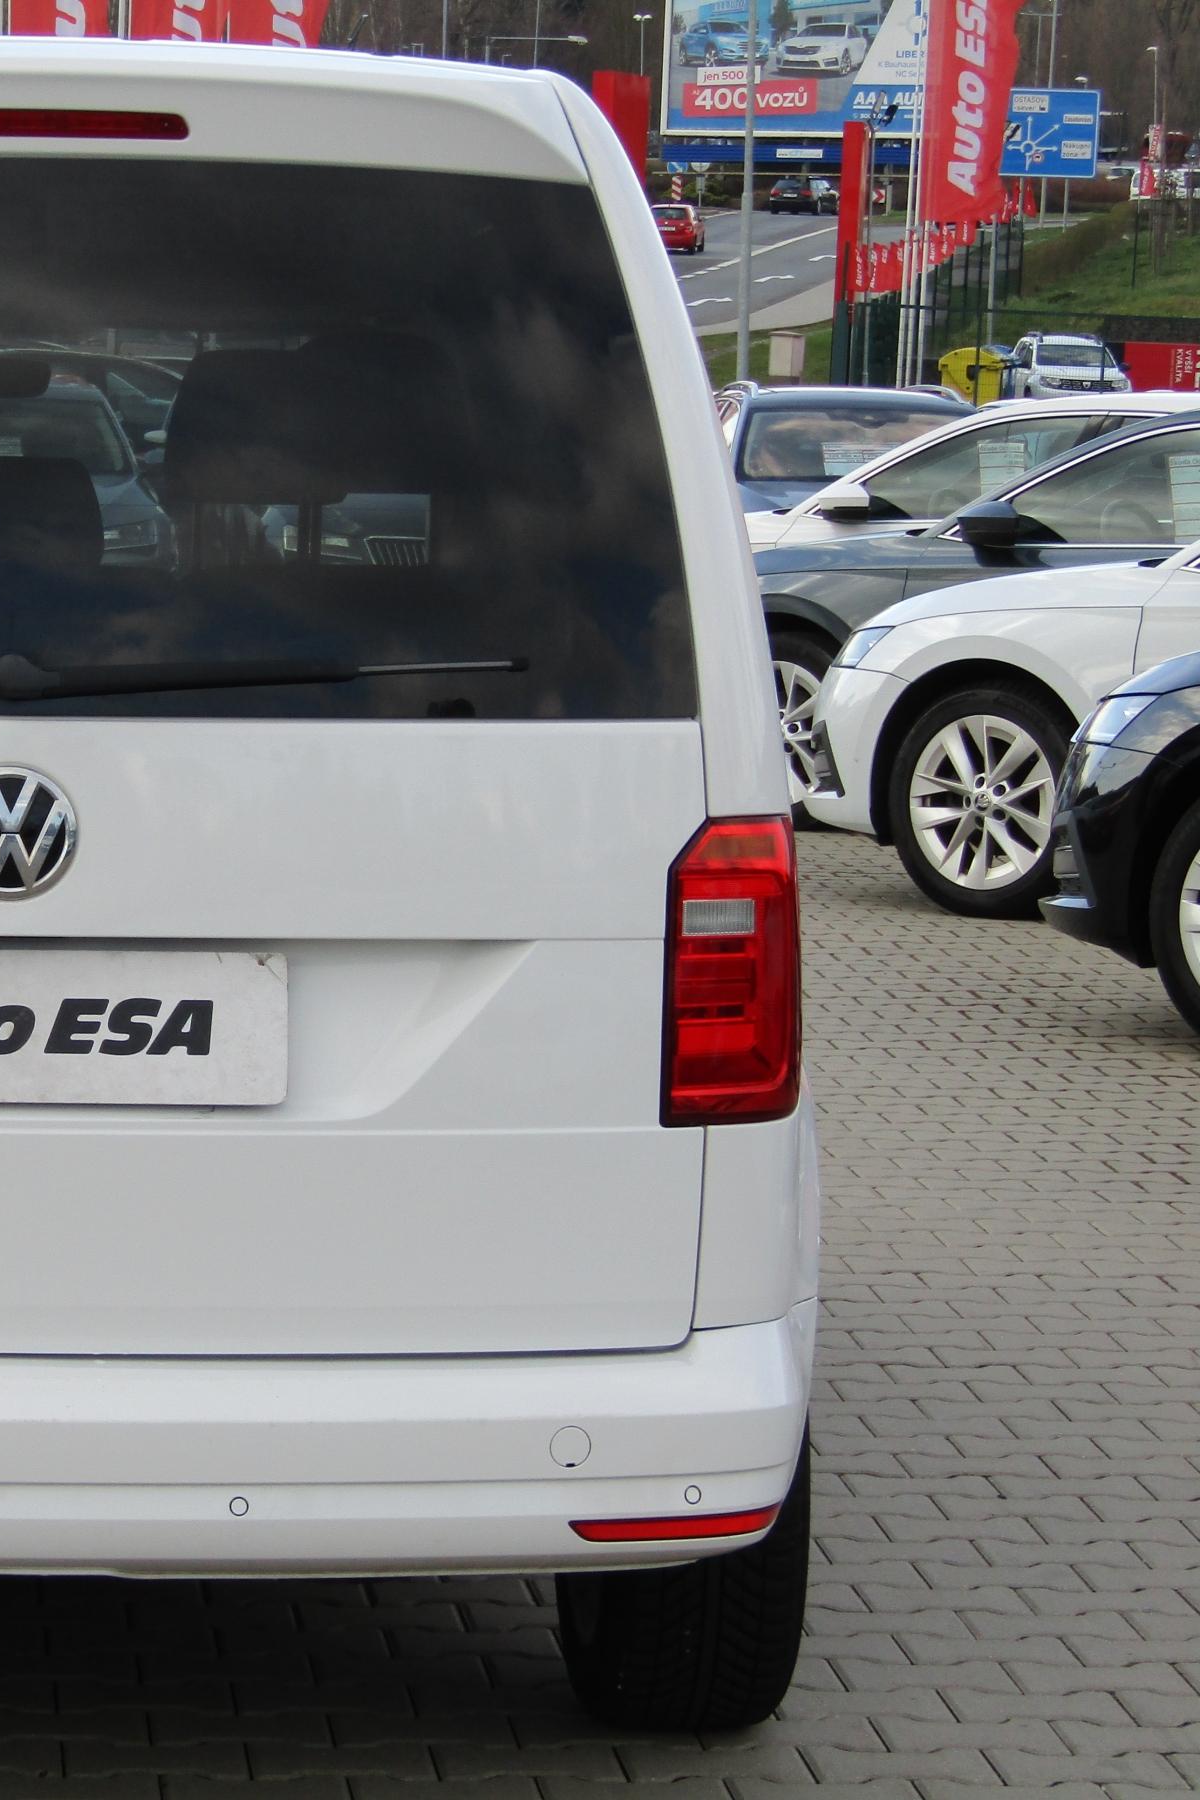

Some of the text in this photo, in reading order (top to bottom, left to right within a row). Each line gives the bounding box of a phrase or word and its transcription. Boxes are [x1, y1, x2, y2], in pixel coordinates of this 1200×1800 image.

[703, 70, 744, 83] jen 500
[694, 87, 748, 111] 400
[947, 70, 986, 197] Auto
[1175, 348, 1184, 384] KVALITA
[44, 997, 214, 1056] ESA
